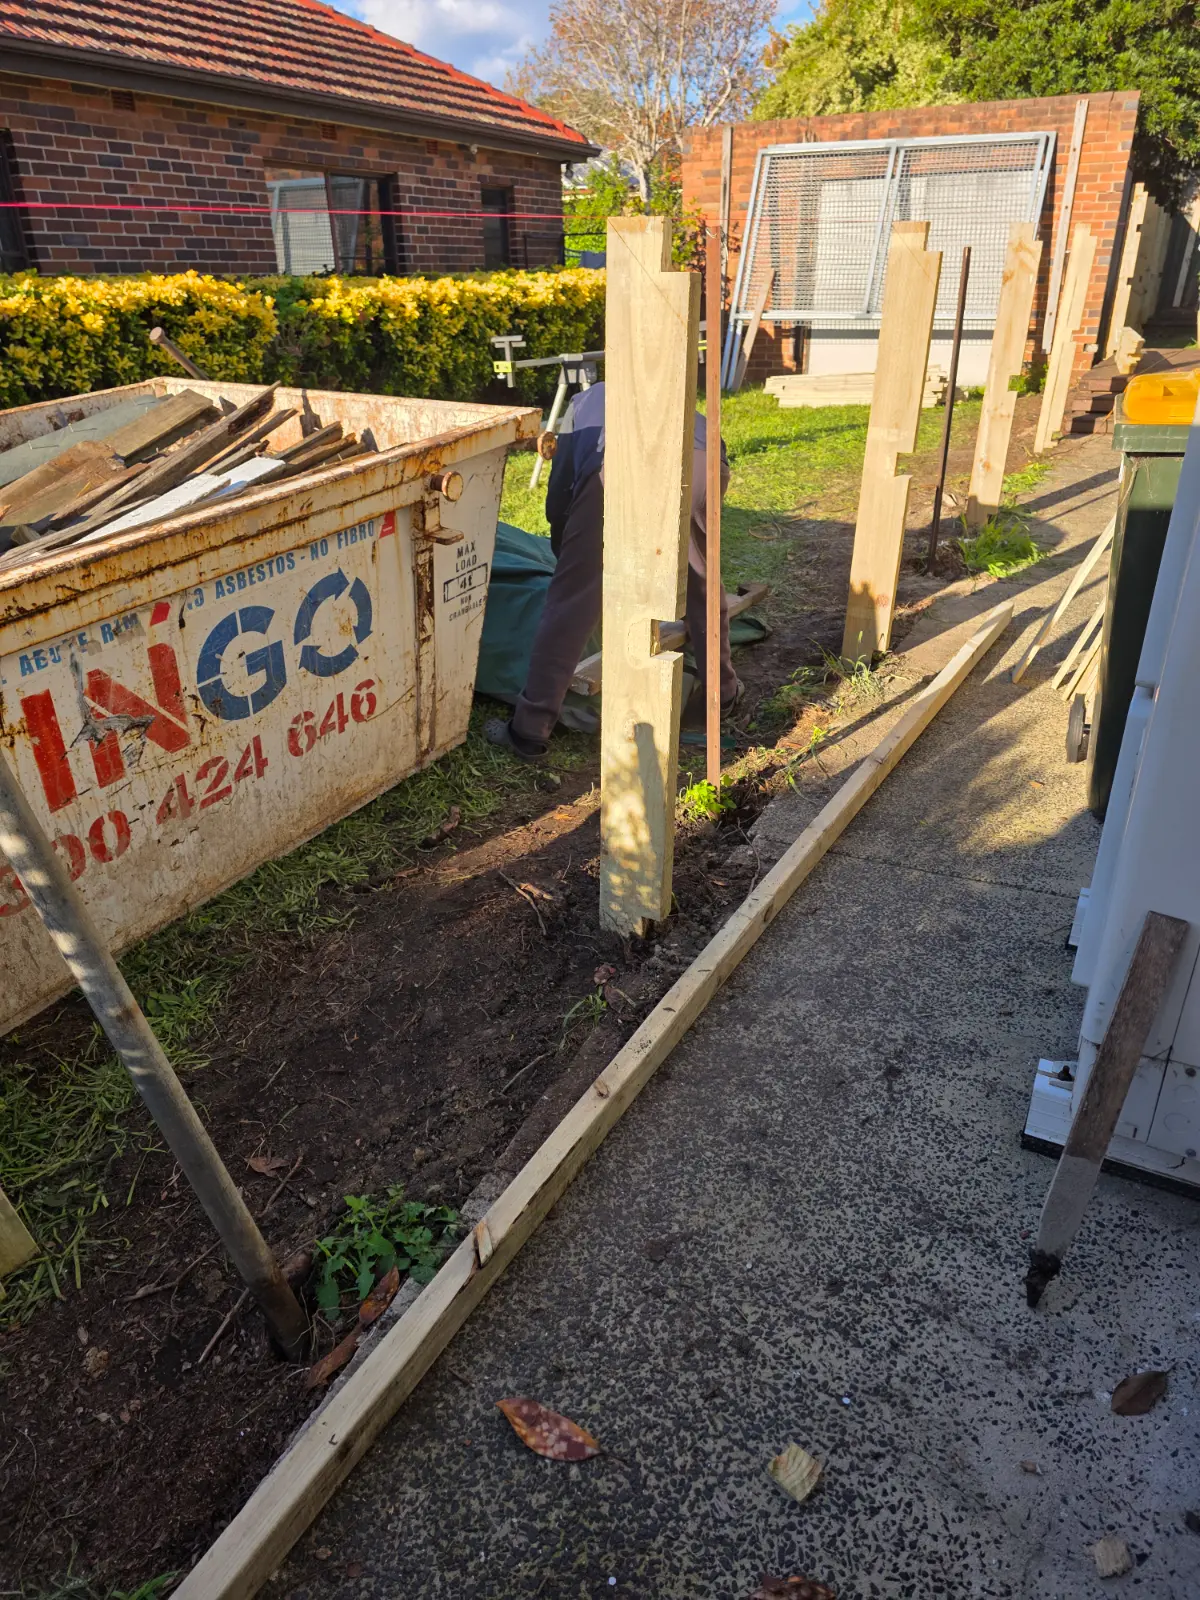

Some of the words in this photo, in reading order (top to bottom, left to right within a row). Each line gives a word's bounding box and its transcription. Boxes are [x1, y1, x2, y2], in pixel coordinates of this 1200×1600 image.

[215, 552, 295, 600] ASBESTOS
[310, 538, 329, 561] NO
[337, 519, 375, 550] FIBRO
[456, 554, 477, 573] LOAD
[457, 540, 476, 559] MAX
[156, 735, 268, 825] 424
[288, 679, 377, 757] 646
